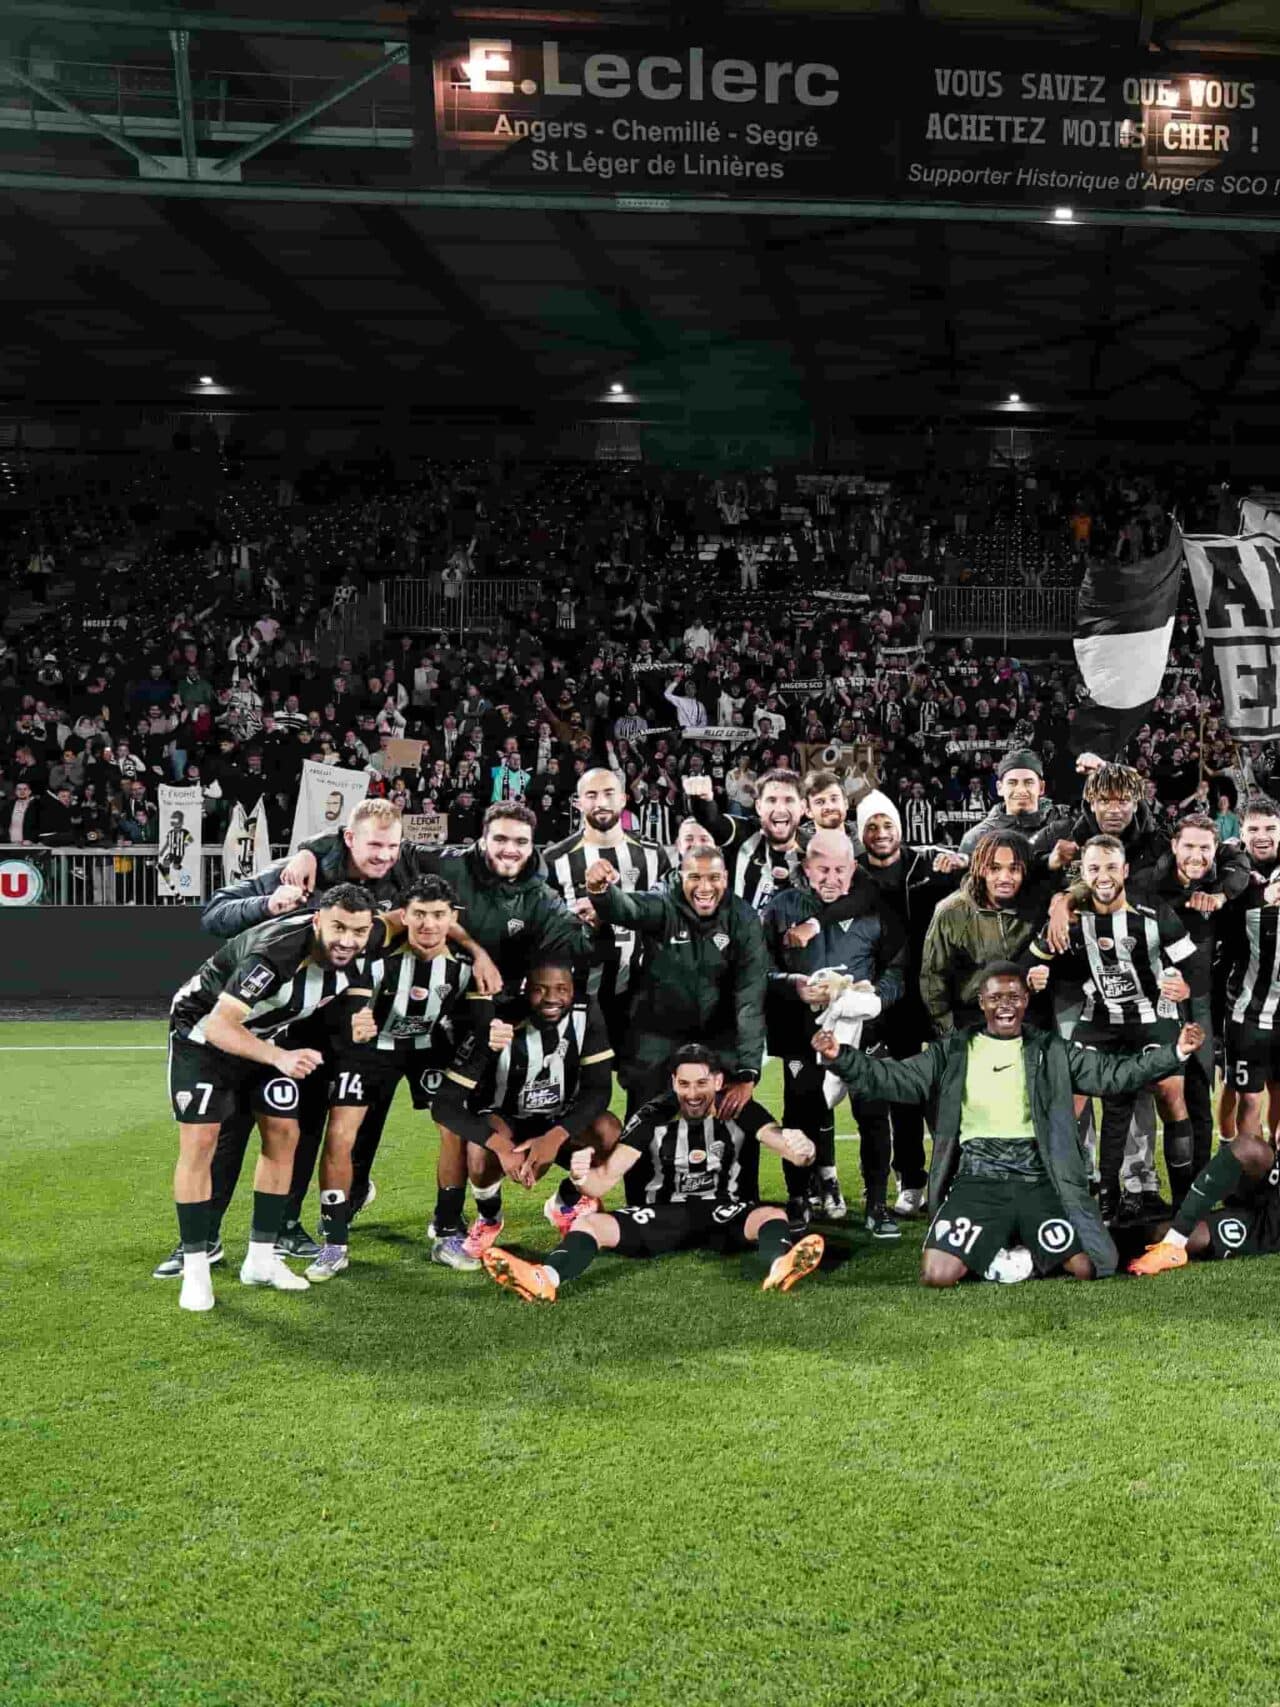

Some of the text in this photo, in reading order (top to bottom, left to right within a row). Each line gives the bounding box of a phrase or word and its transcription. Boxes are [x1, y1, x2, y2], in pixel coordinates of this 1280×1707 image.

[468, 38, 840, 107] E.Leclerc
[935, 67, 1257, 111] VOUS SAVEZ QUE VOUS
[494, 113, 588, 142] Angers
[611, 117, 722, 144] Chemillé
[745, 122, 819, 148] Segré
[925, 112, 1046, 145] ACHETEZ
[1062, 119, 1148, 149] MOINS
[1163, 121, 1231, 152] CHER
[531, 149, 785, 180] St Léger de Linières
[908, 163, 1011, 188] Supporter
[1016, 168, 1120, 193] Historique
[1125, 170, 1215, 196] d'Angers
[1221, 175, 1269, 196] SCO
[2, 873, 28, 898] U
[338, 1072, 364, 1100] 14
[1234, 1060, 1250, 1087] 5
[195, 1083, 213, 1115] 7
[272, 1085, 294, 1104] U
[949, 1216, 983, 1255] 31
[1047, 1223, 1066, 1247] U
